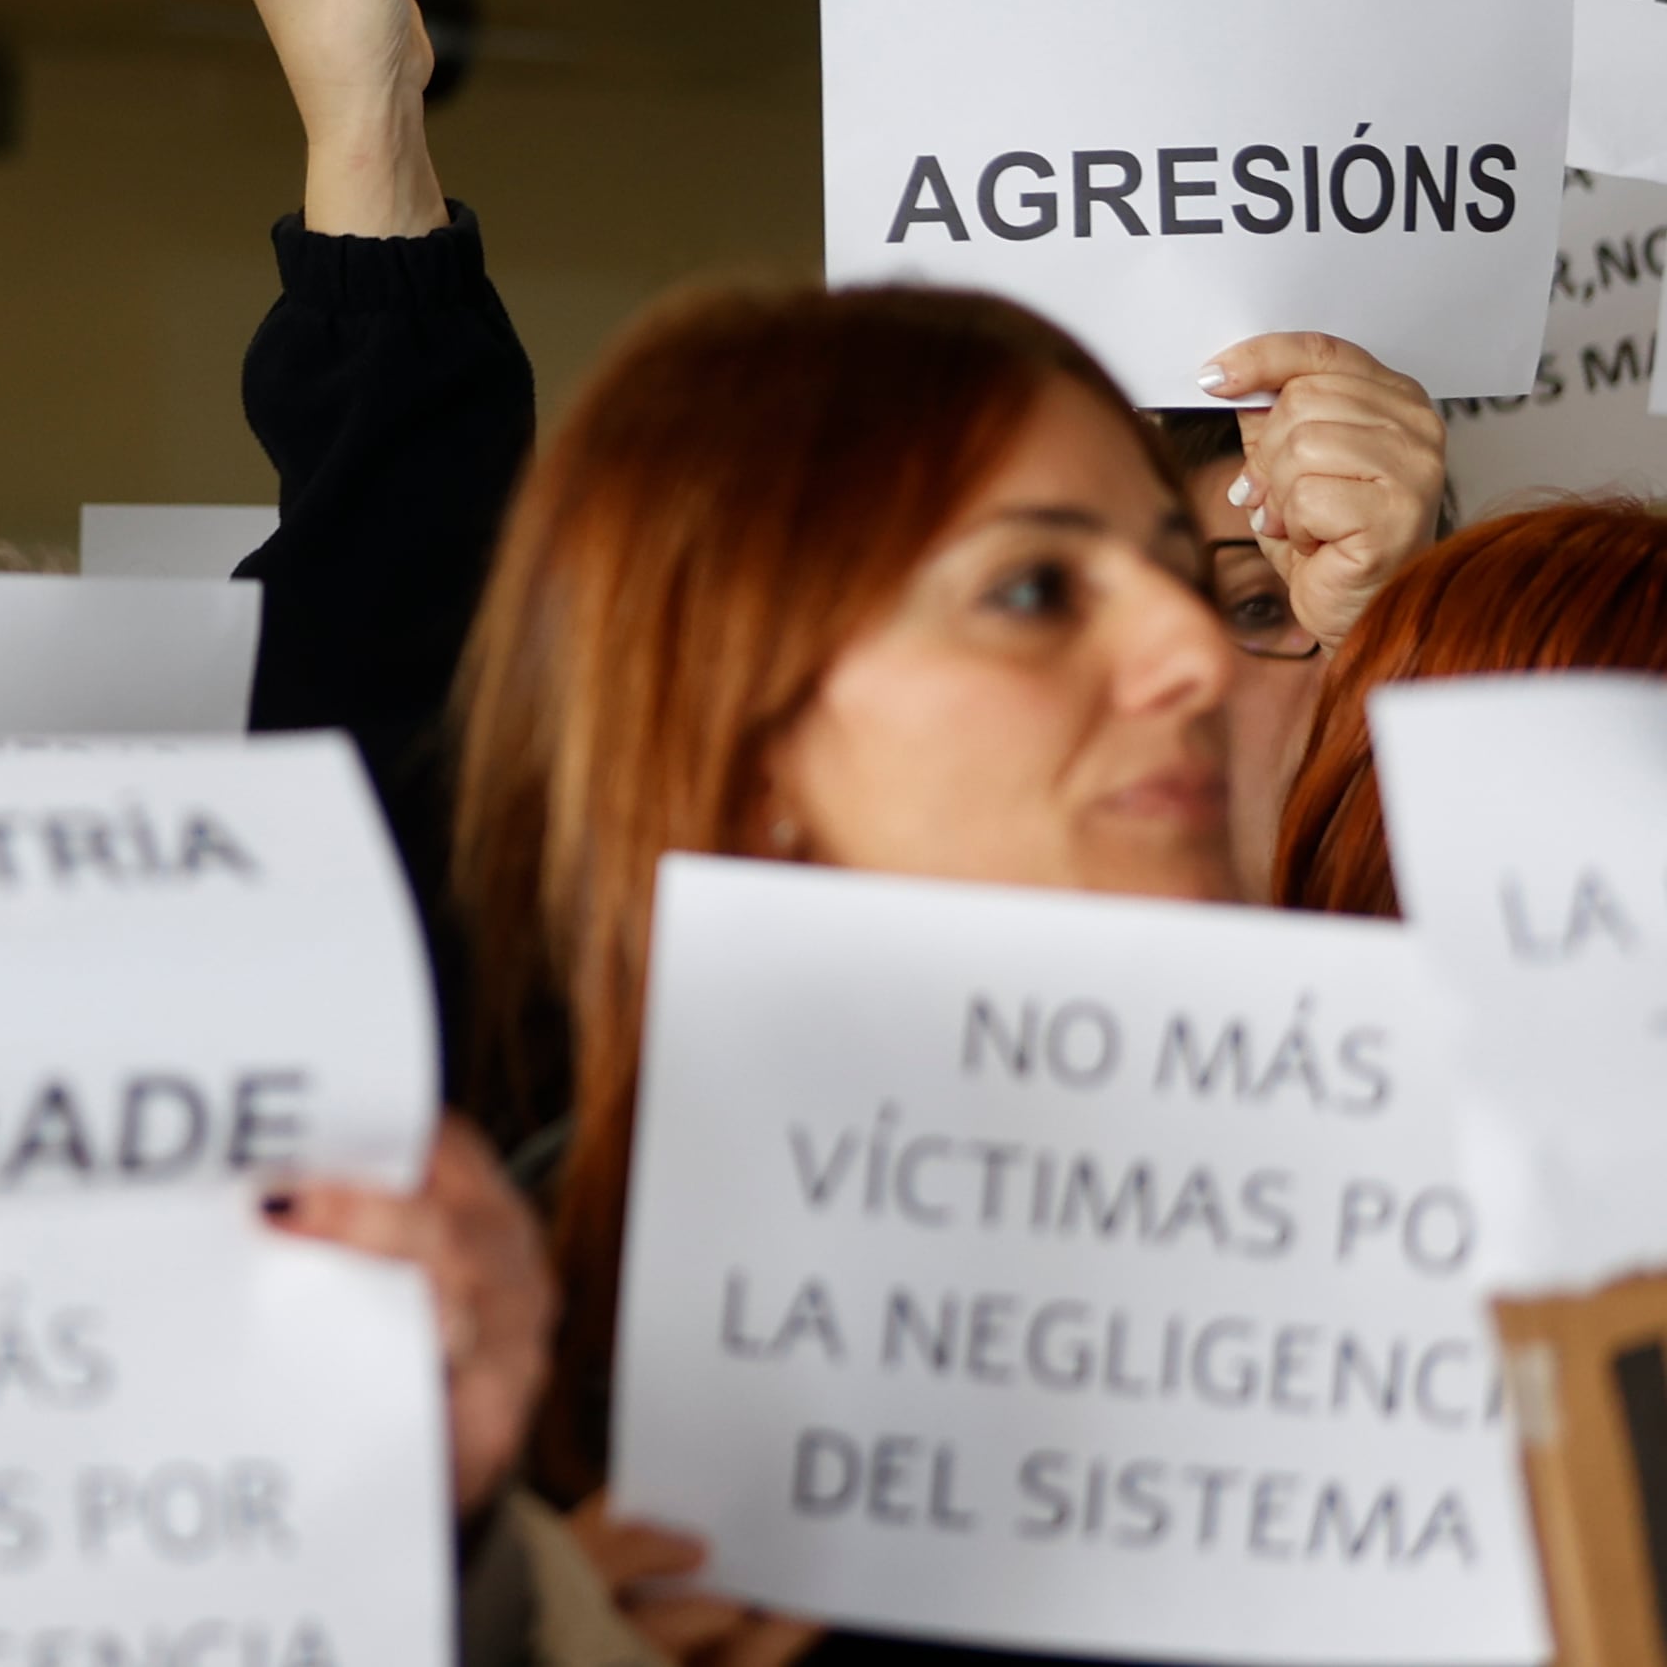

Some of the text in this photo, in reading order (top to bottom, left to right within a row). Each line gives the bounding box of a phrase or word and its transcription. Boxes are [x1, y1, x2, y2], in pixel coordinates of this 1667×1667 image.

[886, 122, 1518, 244] AGRESIÓNS
[960, 986, 1396, 1119] NO MÁS
[786, 1100, 1478, 1280] VÍCTIMAS PO
[717, 1265, 1509, 1431] LA NEGLIGENC
[72, 1456, 298, 1570] POR
[789, 1424, 1482, 1570] DEL SISTEMA
